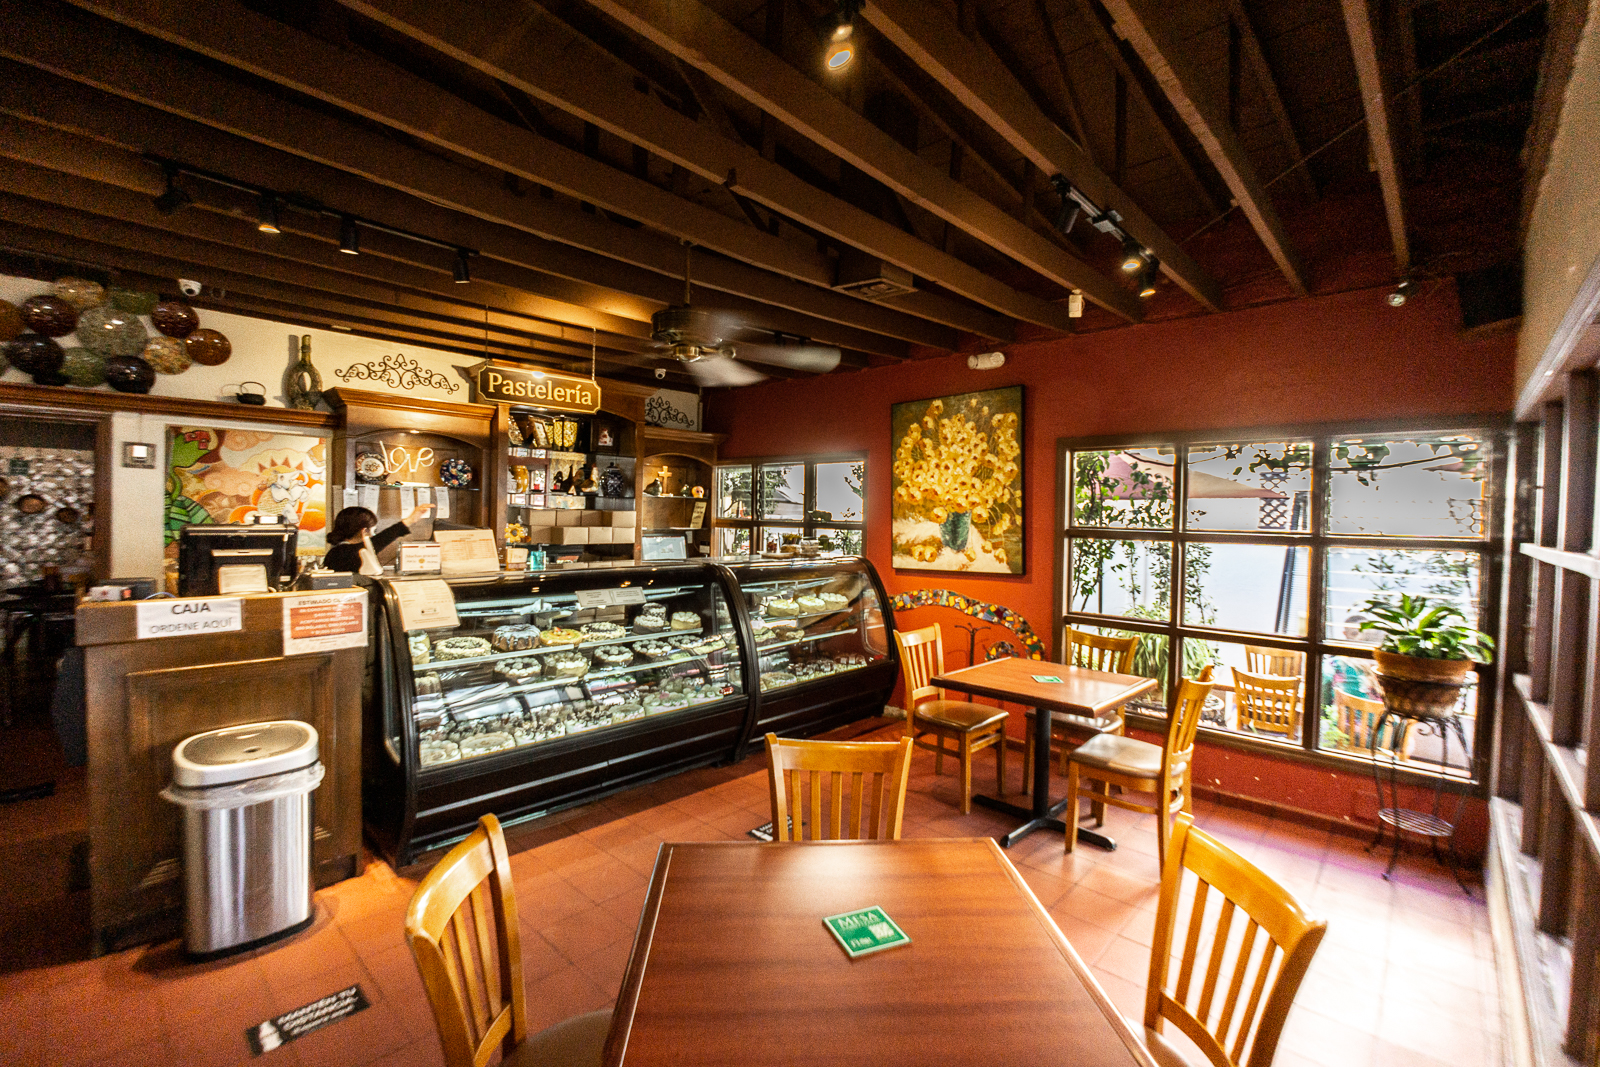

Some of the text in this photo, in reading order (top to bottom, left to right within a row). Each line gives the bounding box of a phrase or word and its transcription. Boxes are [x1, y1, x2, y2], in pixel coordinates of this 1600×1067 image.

[487, 372, 592, 406] Pastelería
[172, 603, 211, 614] CAJA
[150, 622, 199, 633] ORDENE
